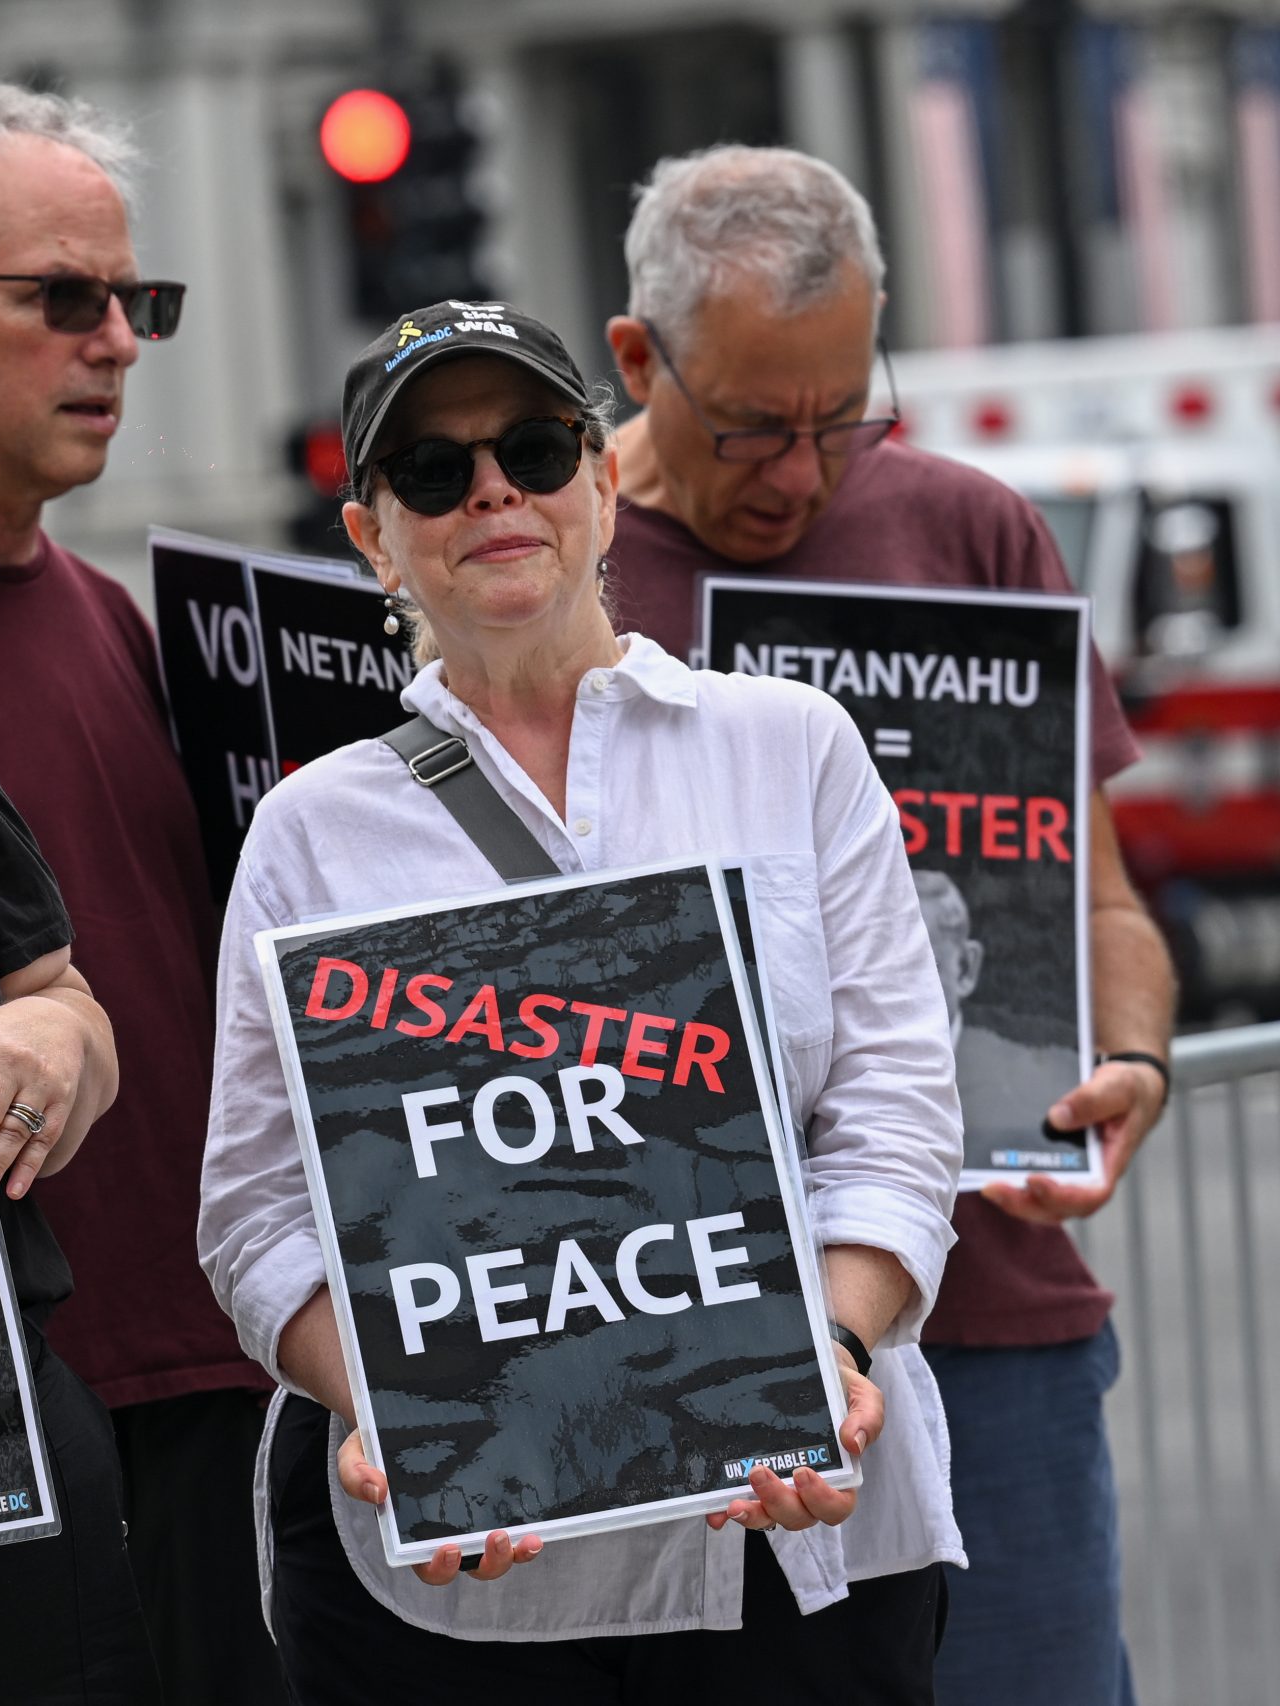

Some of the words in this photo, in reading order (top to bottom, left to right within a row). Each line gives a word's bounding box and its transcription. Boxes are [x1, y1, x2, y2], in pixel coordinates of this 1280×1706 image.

[454, 321, 519, 340] WAR
[187, 599, 259, 687] VO
[280, 627, 413, 693] NETAN
[733, 642, 1040, 707] NETANYAHU
[890, 788, 1072, 863] STER
[304, 956, 732, 1094] DISASTER
[401, 1063, 646, 1179] FOR
[388, 1211, 762, 1356] PEACE
[807, 1447, 829, 1465] DC
[8, 1492, 29, 1511] DC
